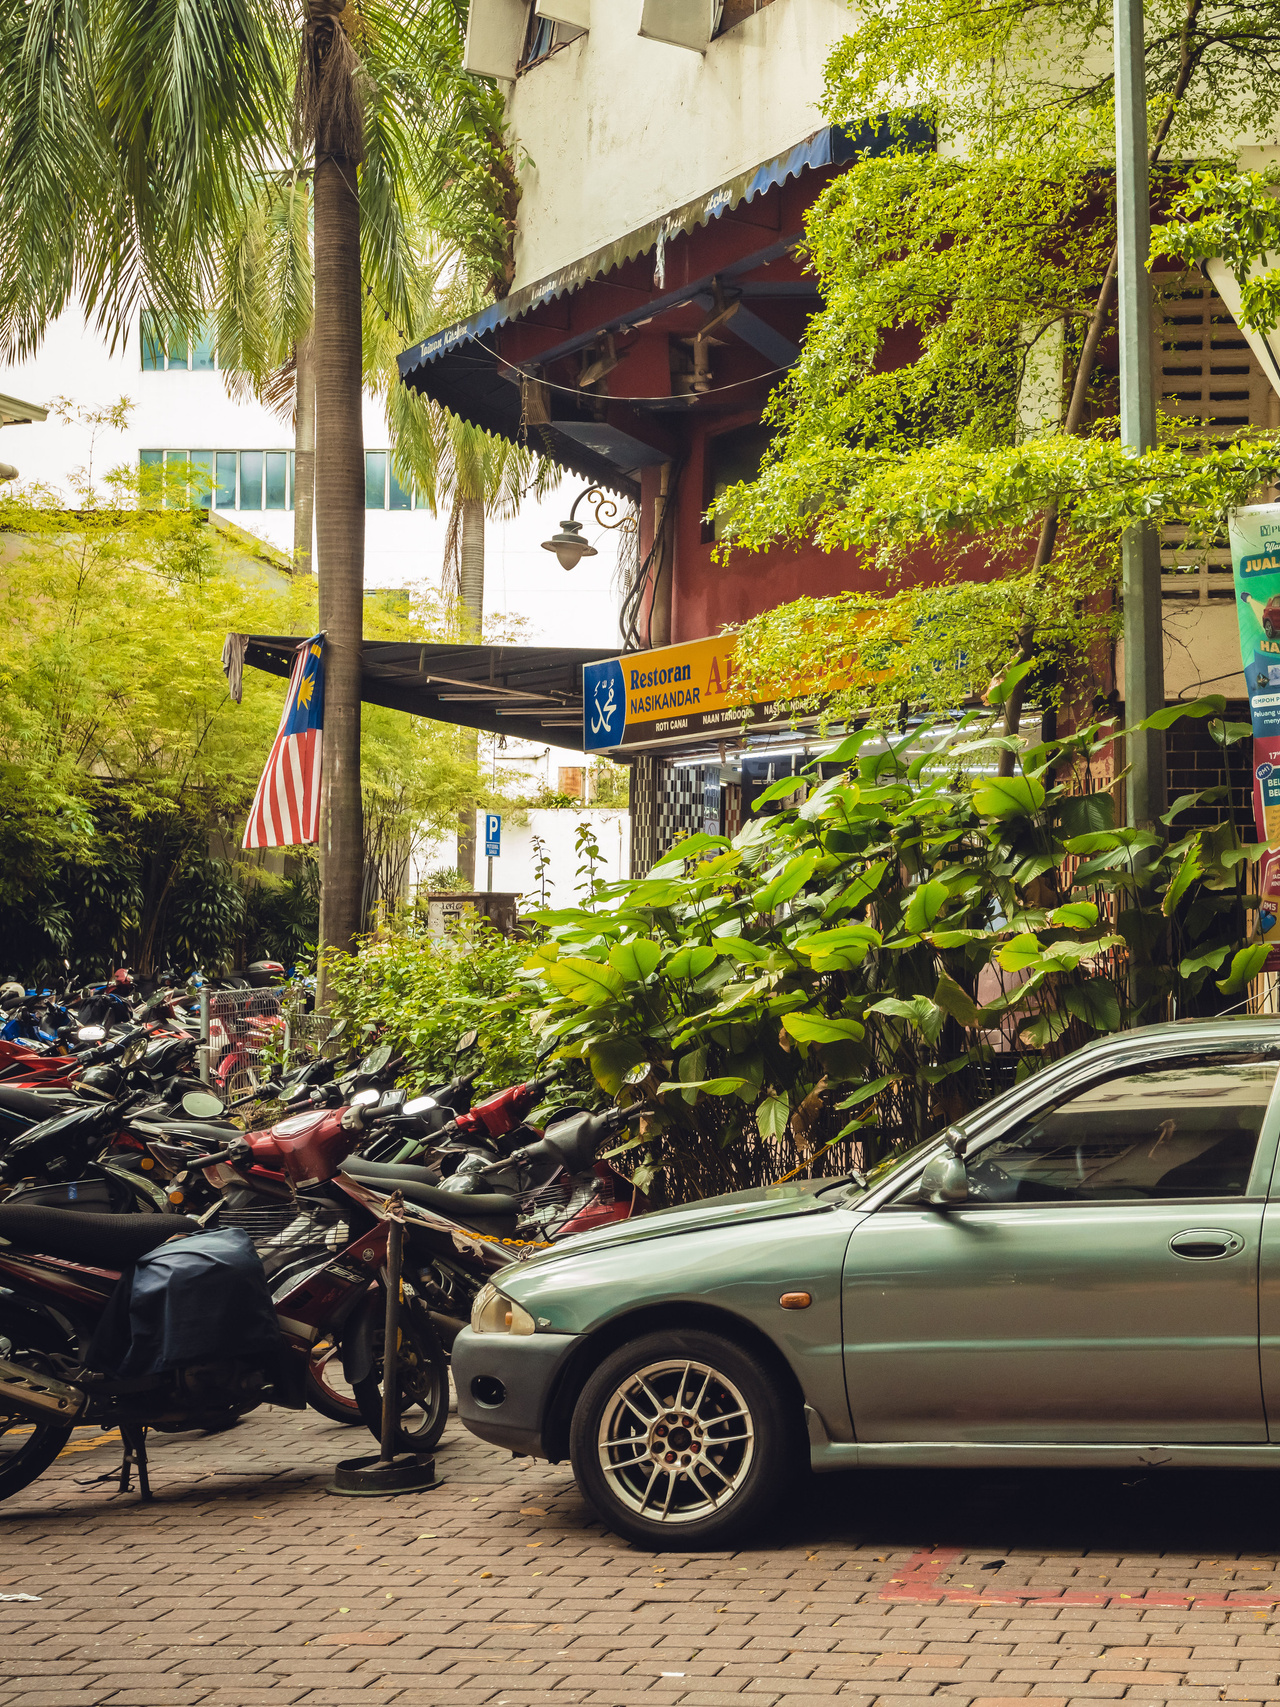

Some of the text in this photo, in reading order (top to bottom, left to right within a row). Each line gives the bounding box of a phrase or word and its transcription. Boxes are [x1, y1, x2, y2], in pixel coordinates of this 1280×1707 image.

[420, 340, 442, 357] Taiwan
[630, 664, 691, 690] Restoran
[630, 687, 700, 714] NASIKANDAR
[655, 721, 669, 732] ROTI
[670, 719, 688, 730] CANAI
[702, 713, 720, 725] NAAN
[1254, 710, 1276, 718] Peluang
[1258, 766, 1270, 777] RM1
[489, 816, 498, 840] P
